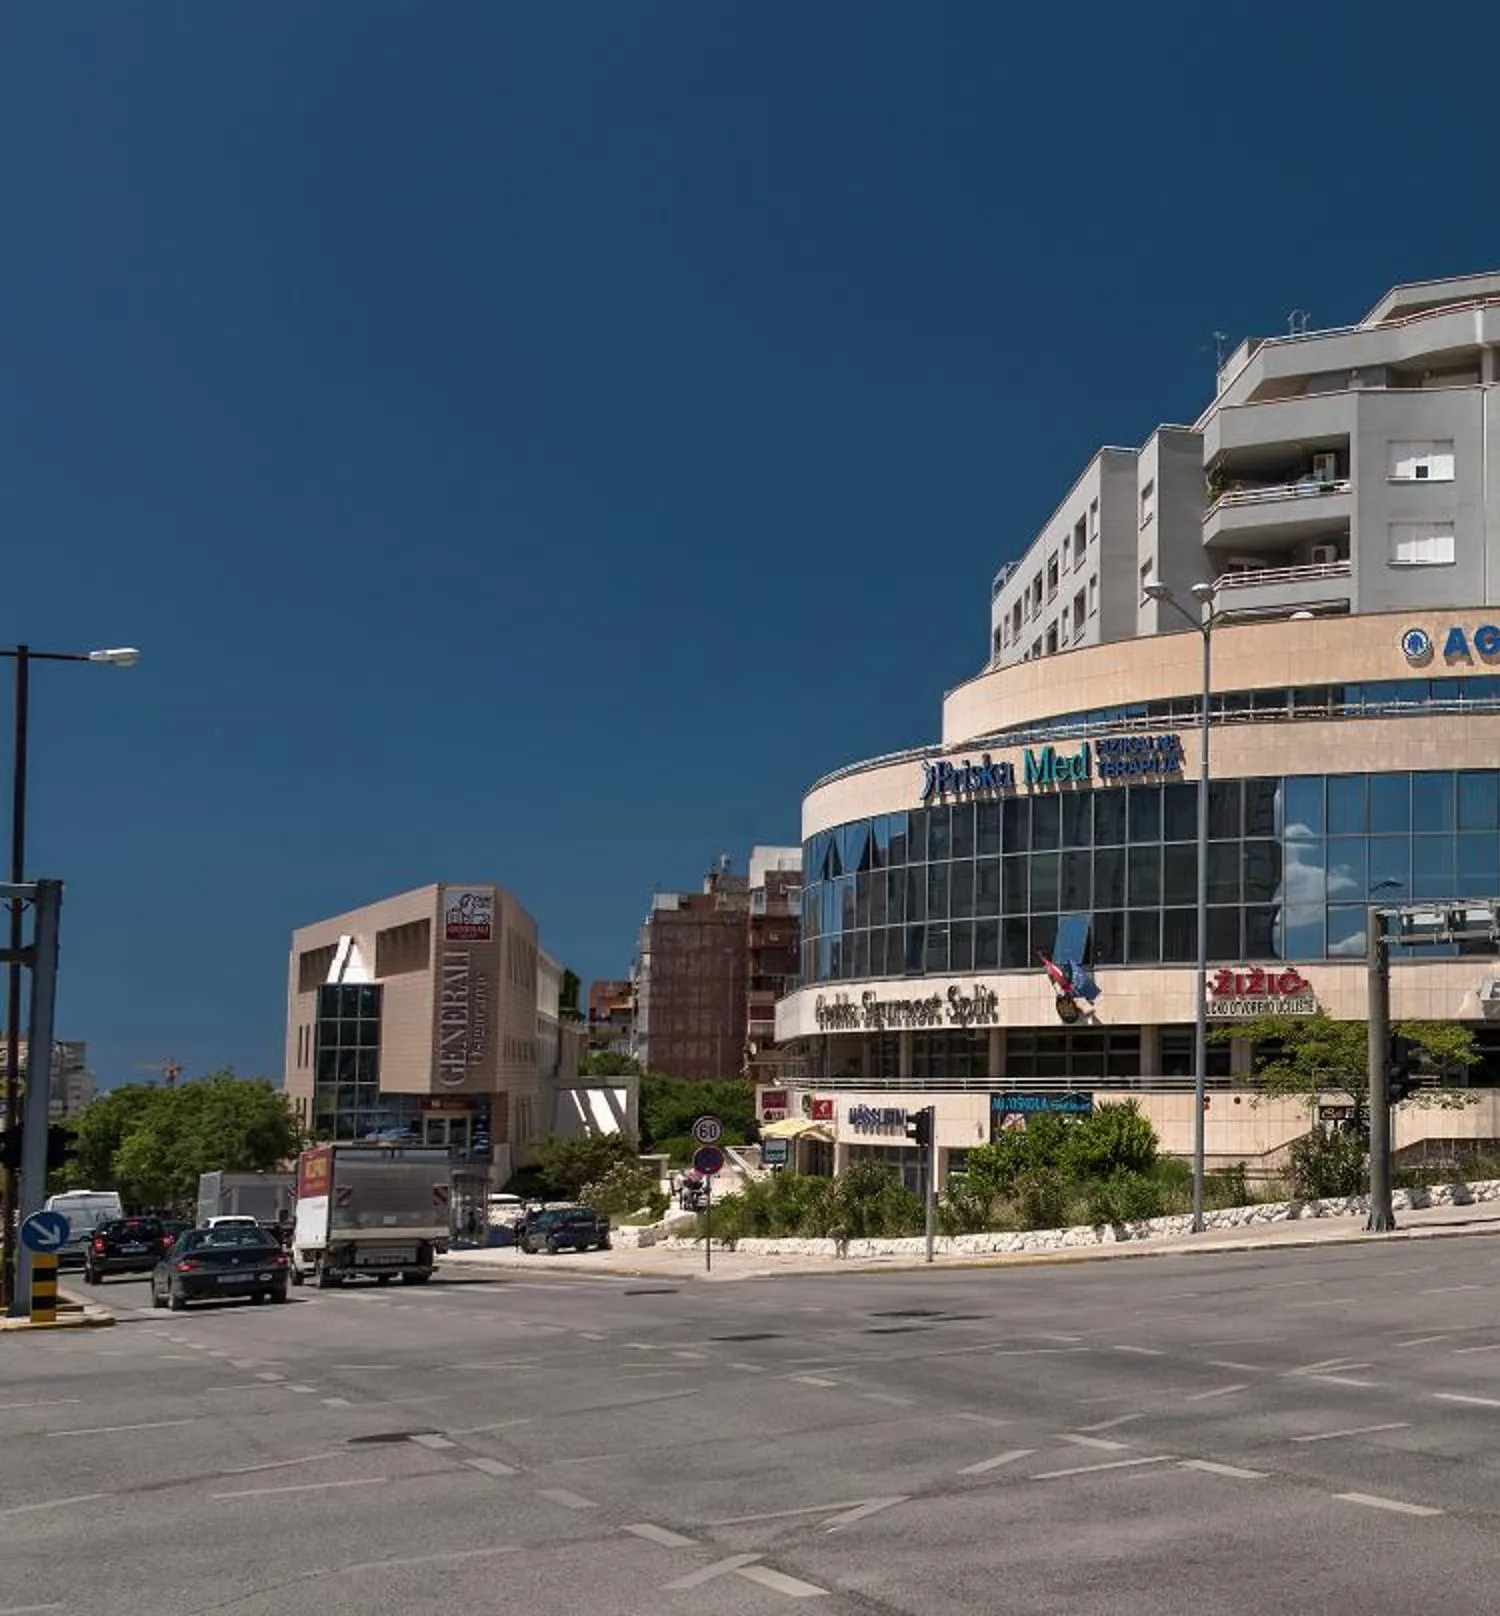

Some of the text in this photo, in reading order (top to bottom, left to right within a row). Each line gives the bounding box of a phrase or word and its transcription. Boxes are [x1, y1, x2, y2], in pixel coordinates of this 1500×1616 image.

[934, 740, 1091, 794] Priska Med
[439, 951, 470, 1087] GENERALI
[699, 1123, 718, 1139] 60
